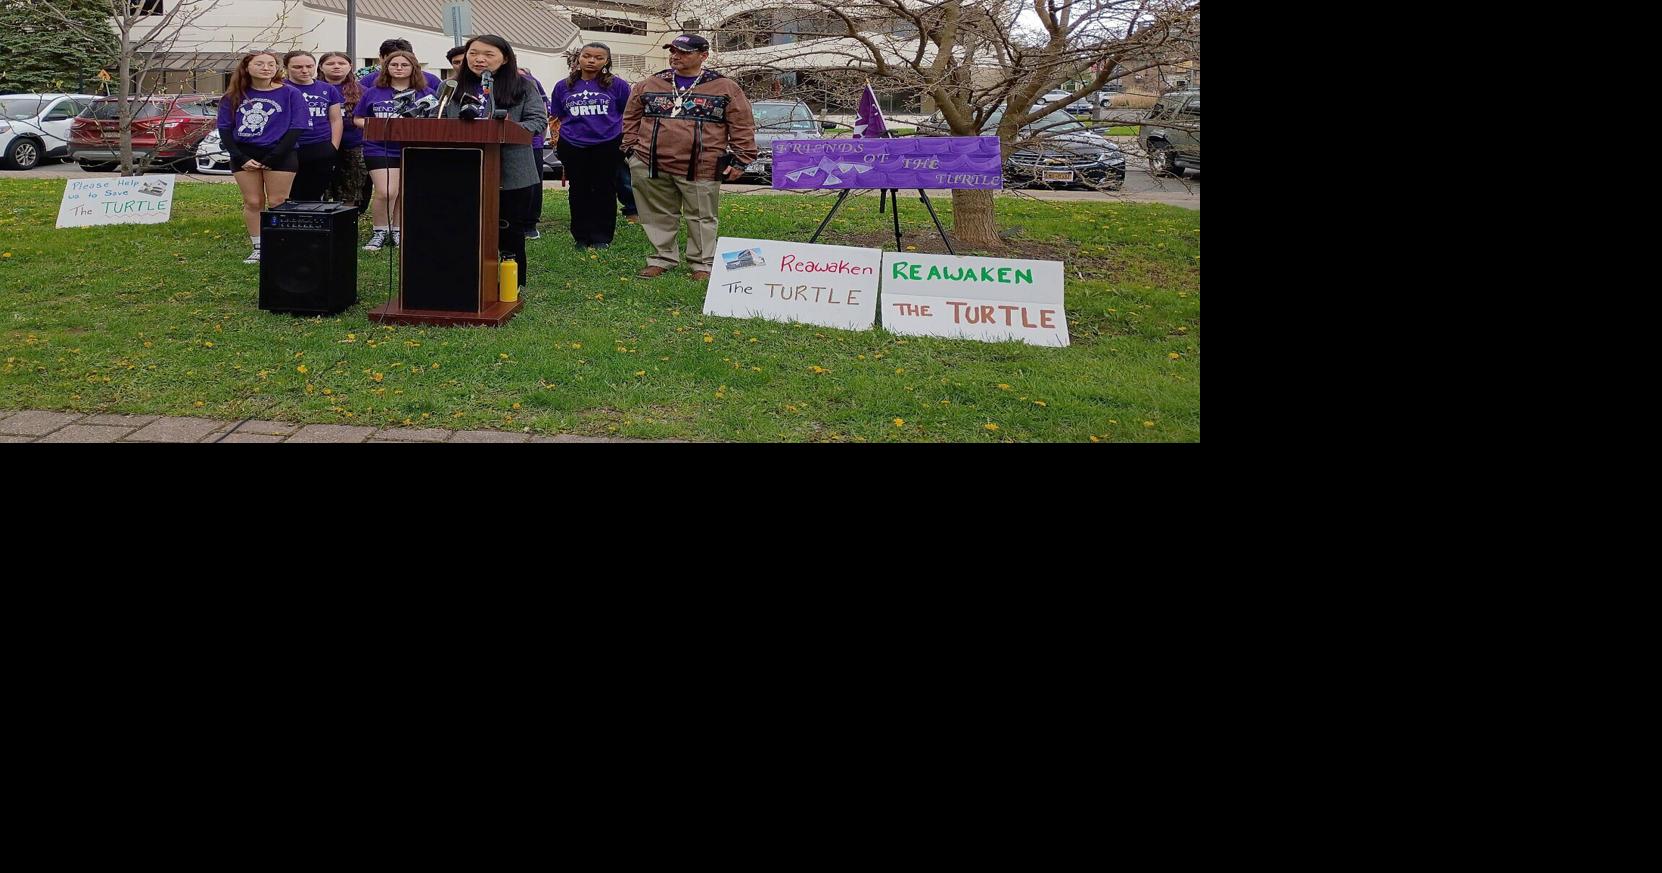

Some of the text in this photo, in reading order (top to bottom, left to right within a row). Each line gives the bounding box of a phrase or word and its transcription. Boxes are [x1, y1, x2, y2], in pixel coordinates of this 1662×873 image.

[309, 107, 327, 117] TLE
[569, 104, 609, 117] URTLE
[776, 143, 864, 155] FRIENDS
[863, 153, 939, 170] OF THE
[73, 179, 139, 190] Please Help
[935, 173, 1001, 186] TURTLE
[70, 199, 168, 216] The TURTLE
[780, 254, 873, 275] Reawaken
[892, 261, 1033, 284] REAWAKEN
[722, 280, 862, 305] The TURTLE
[892, 301, 1056, 329] THE TURTLE
